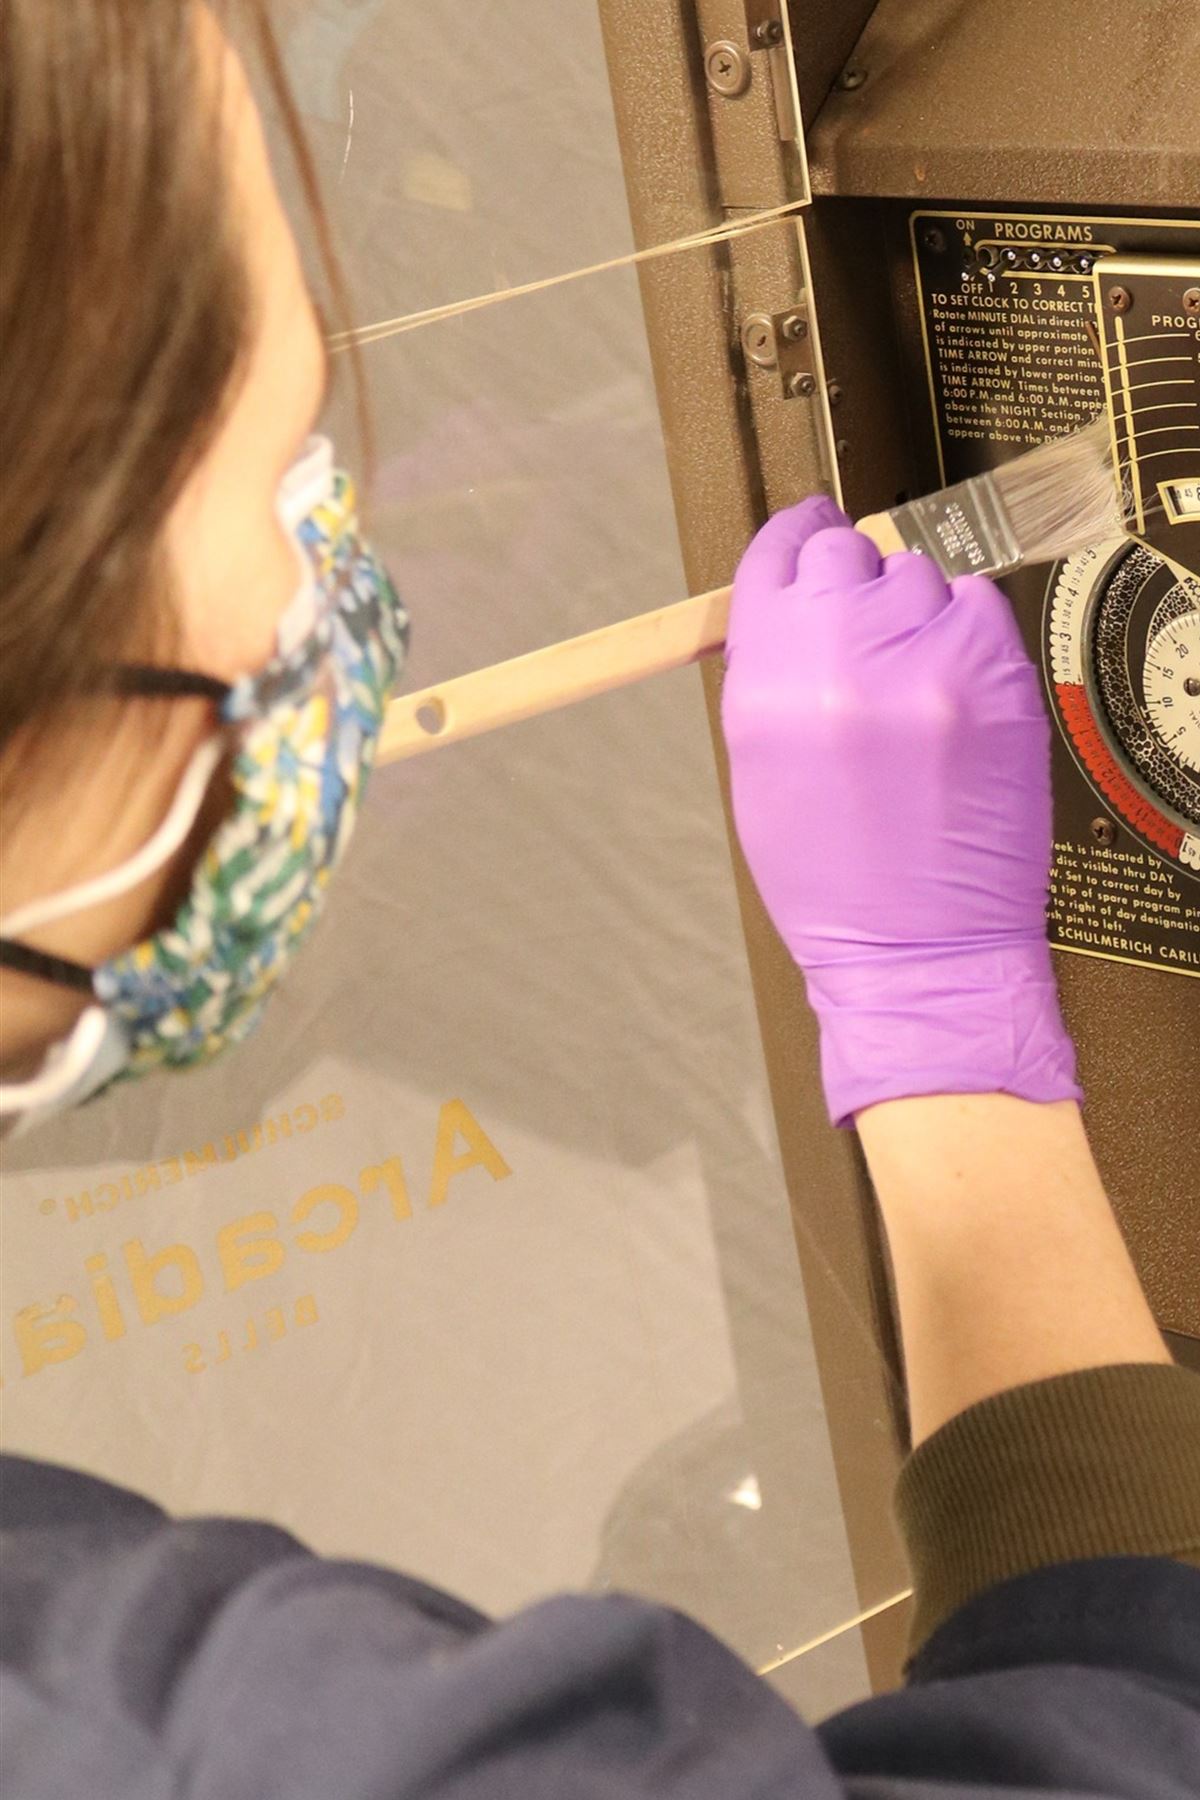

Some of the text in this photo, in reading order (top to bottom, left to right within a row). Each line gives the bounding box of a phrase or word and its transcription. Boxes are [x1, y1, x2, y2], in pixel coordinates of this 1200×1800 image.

[956, 219, 975, 231] ON
[994, 223, 1093, 241] PROGRAMS
[961, 283, 983, 294] OFF
[1010, 282, 1090, 298] 2 3 4 5
[931, 293, 1083, 313] TO SET CLOCK TO CORRECT
[933, 309, 1036, 325] Rotate MINUTE DIAL
[949, 325, 1088, 342] arrows until approximate
[948, 337, 1095, 356] indicated by upper portion
[938, 348, 1073, 367] TIME ARROW and correct
[951, 363, 1000, 376] indicated
[1004, 366, 1017, 378] by
[1022, 367, 1052, 379] lower
[1056, 371, 1097, 383] portion
[942, 375, 1100, 397] TIME ARROW. Times between
[943, 388, 1043, 404] 6:00 6:00
[945, 401, 977, 412] above
[980, 403, 997, 414] the
[1001, 405, 1037, 417] NIGHT
[1041, 408, 1084, 421] Section.
[946, 414, 1020, 428] between 6:00
[948, 428, 1021, 442] appear above
[1175, 643, 1189, 659] 20
[1162, 666, 1174, 680] 15
[1090, 845, 1162, 870] indicated by
[1056, 855, 1174, 885] disc visible thru DAY
[1065, 871, 1082, 884] Set
[1086, 875, 1098, 886] to
[1102, 878, 1140, 893] correct
[1143, 882, 1164, 899] day
[1167, 888, 1182, 901] by
[1061, 885, 1077, 898] tip
[1081, 887, 1093, 899] of
[1097, 892, 1128, 906] spare
[1132, 898, 1181, 917] program
[1069, 900, 1096, 914] right
[1100, 905, 1112, 916] of
[1116, 907, 1137, 923] day
[1066, 913, 1127, 933] pin to left.
[1058, 926, 1153, 955] SCHULMERICH
